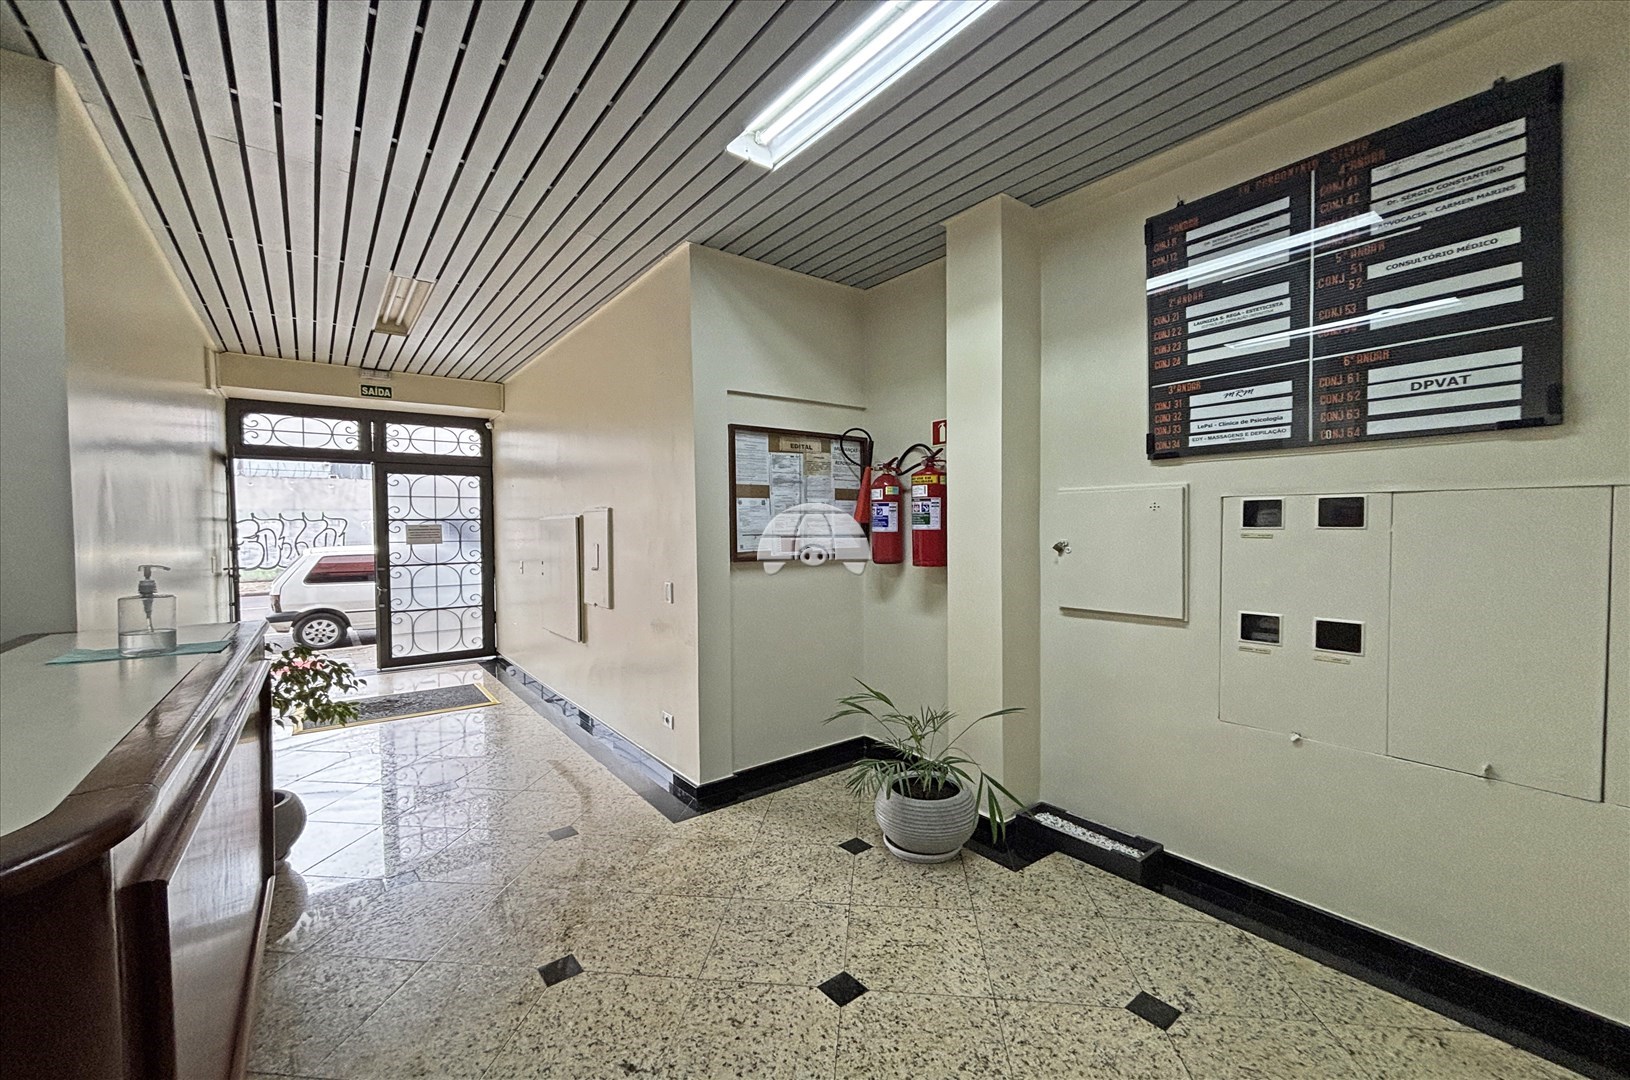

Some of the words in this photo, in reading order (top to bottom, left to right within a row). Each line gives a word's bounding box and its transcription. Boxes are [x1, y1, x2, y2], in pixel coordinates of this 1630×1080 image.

[1386, 197, 1399, 206] Dr.
[1401, 184, 1434, 201] SÉRGIO
[1436, 165, 1505, 190] CONSTANTINO
[1435, 196, 1474, 212] CARMEN
[1476, 183, 1517, 201] MARINS
[1386, 248, 1454, 271] CONSULTÓRIO
[1456, 237, 1498, 254] MÉDICO
[1350, 262, 1363, 274] 51
[1317, 272, 1345, 288] CONJ
[1349, 277, 1363, 291] 52
[1318, 305, 1343, 321] CONJ
[1344, 303, 1357, 314] 53
[1171, 327, 1182, 337] 22
[1172, 341, 1182, 351] 23
[1318, 375, 1343, 388] CONJ
[1347, 373, 1360, 384] 61
[1410, 374, 1472, 392] DPVAT
[361, 386, 391, 397] SAÍDA
[1319, 393, 1344, 405] CONJ
[1347, 391, 1361, 402] 62
[1154, 400, 1171, 411] CONJ
[1174, 399, 1182, 409] 31
[1154, 413, 1171, 424] CONJ
[1173, 412, 1182, 421] 32
[1250, 415, 1284, 425] Psicologia
[1320, 410, 1344, 422] CONJ
[1347, 409, 1360, 420] 63
[1154, 425, 1172, 435] CONJ
[1172, 425, 1181, 434] 33
[1207, 431, 1244, 441] MASSAGENS
[1250, 428, 1287, 437] DEPILAÇÃO
[1320, 429, 1344, 440] CONJ
[1347, 427, 1360, 438] 64
[1154, 440, 1172, 451] CONJ
